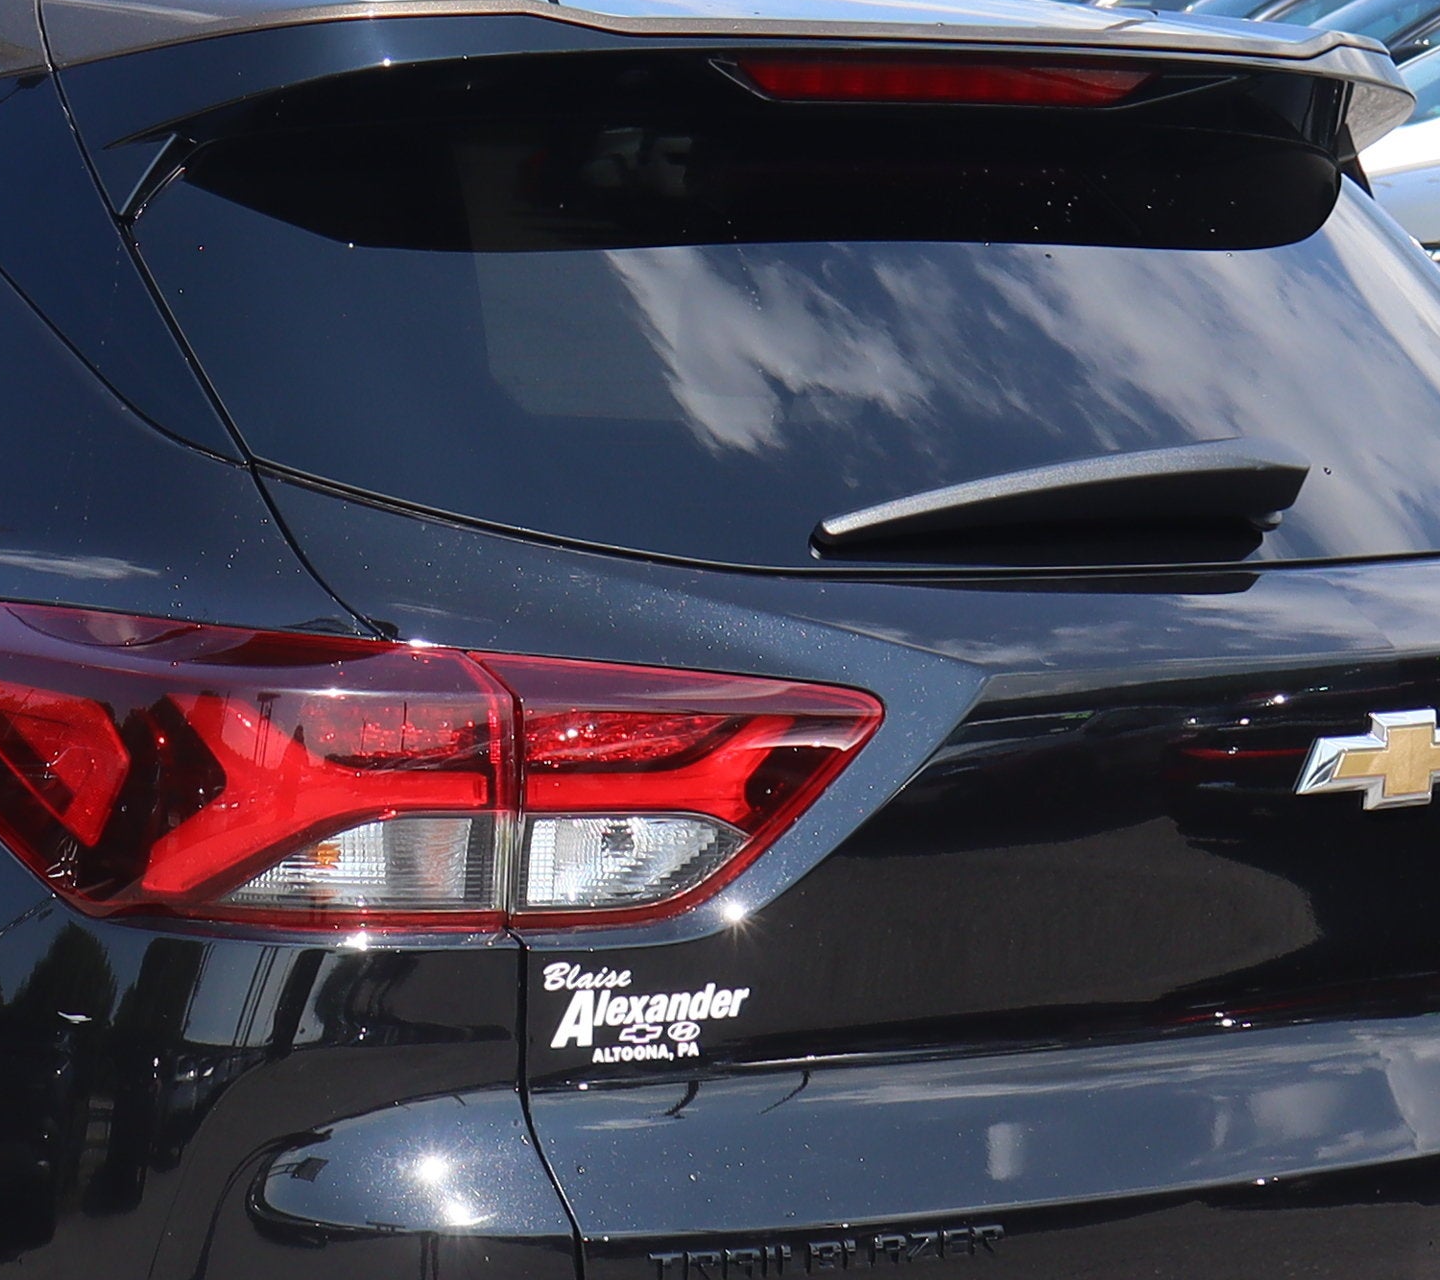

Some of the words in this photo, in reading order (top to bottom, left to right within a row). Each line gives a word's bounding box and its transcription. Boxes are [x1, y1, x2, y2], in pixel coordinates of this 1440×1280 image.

[543, 961, 633, 992] Blaise
[549, 982, 751, 1049] Alexander
[591, 1045, 675, 1064] ALTOONA,
[677, 1041, 700, 1058] PA
